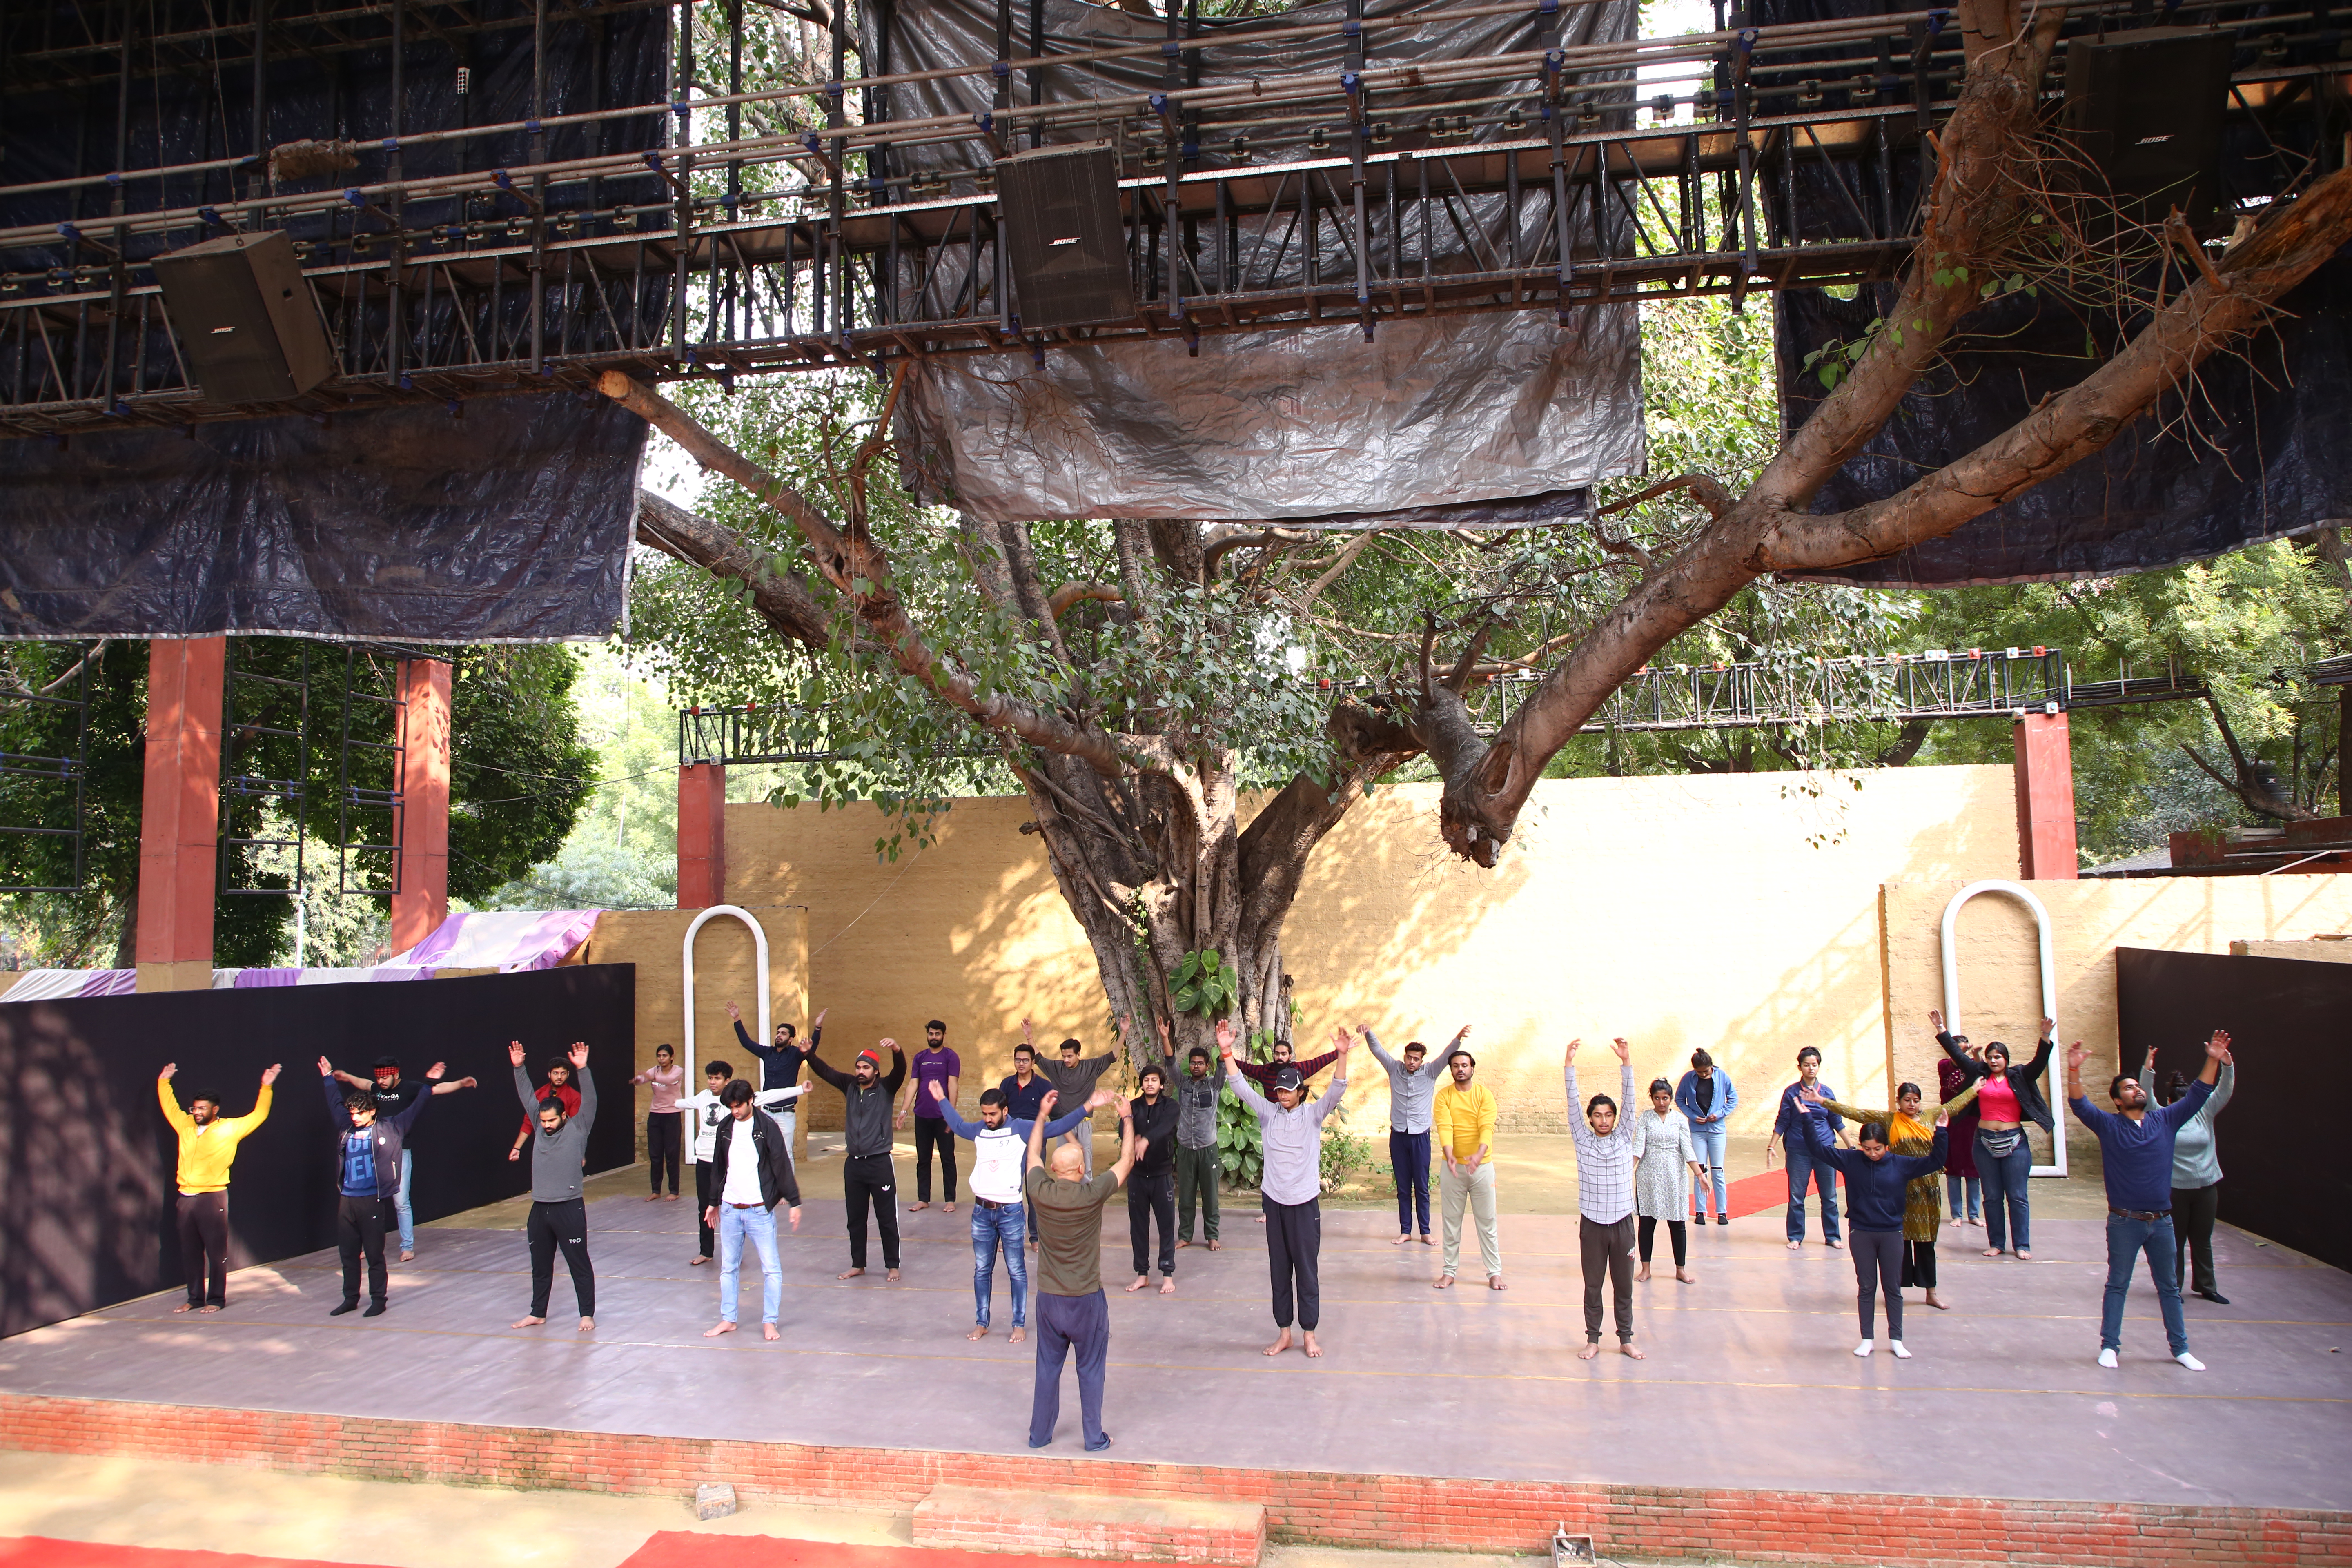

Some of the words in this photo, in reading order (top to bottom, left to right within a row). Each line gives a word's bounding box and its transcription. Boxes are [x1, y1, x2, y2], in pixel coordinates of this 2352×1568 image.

[2135, 135, 2174, 145] BOSE
[1049, 237, 1081, 246] BOSE
[1167, 1190, 1173, 1201] 5
